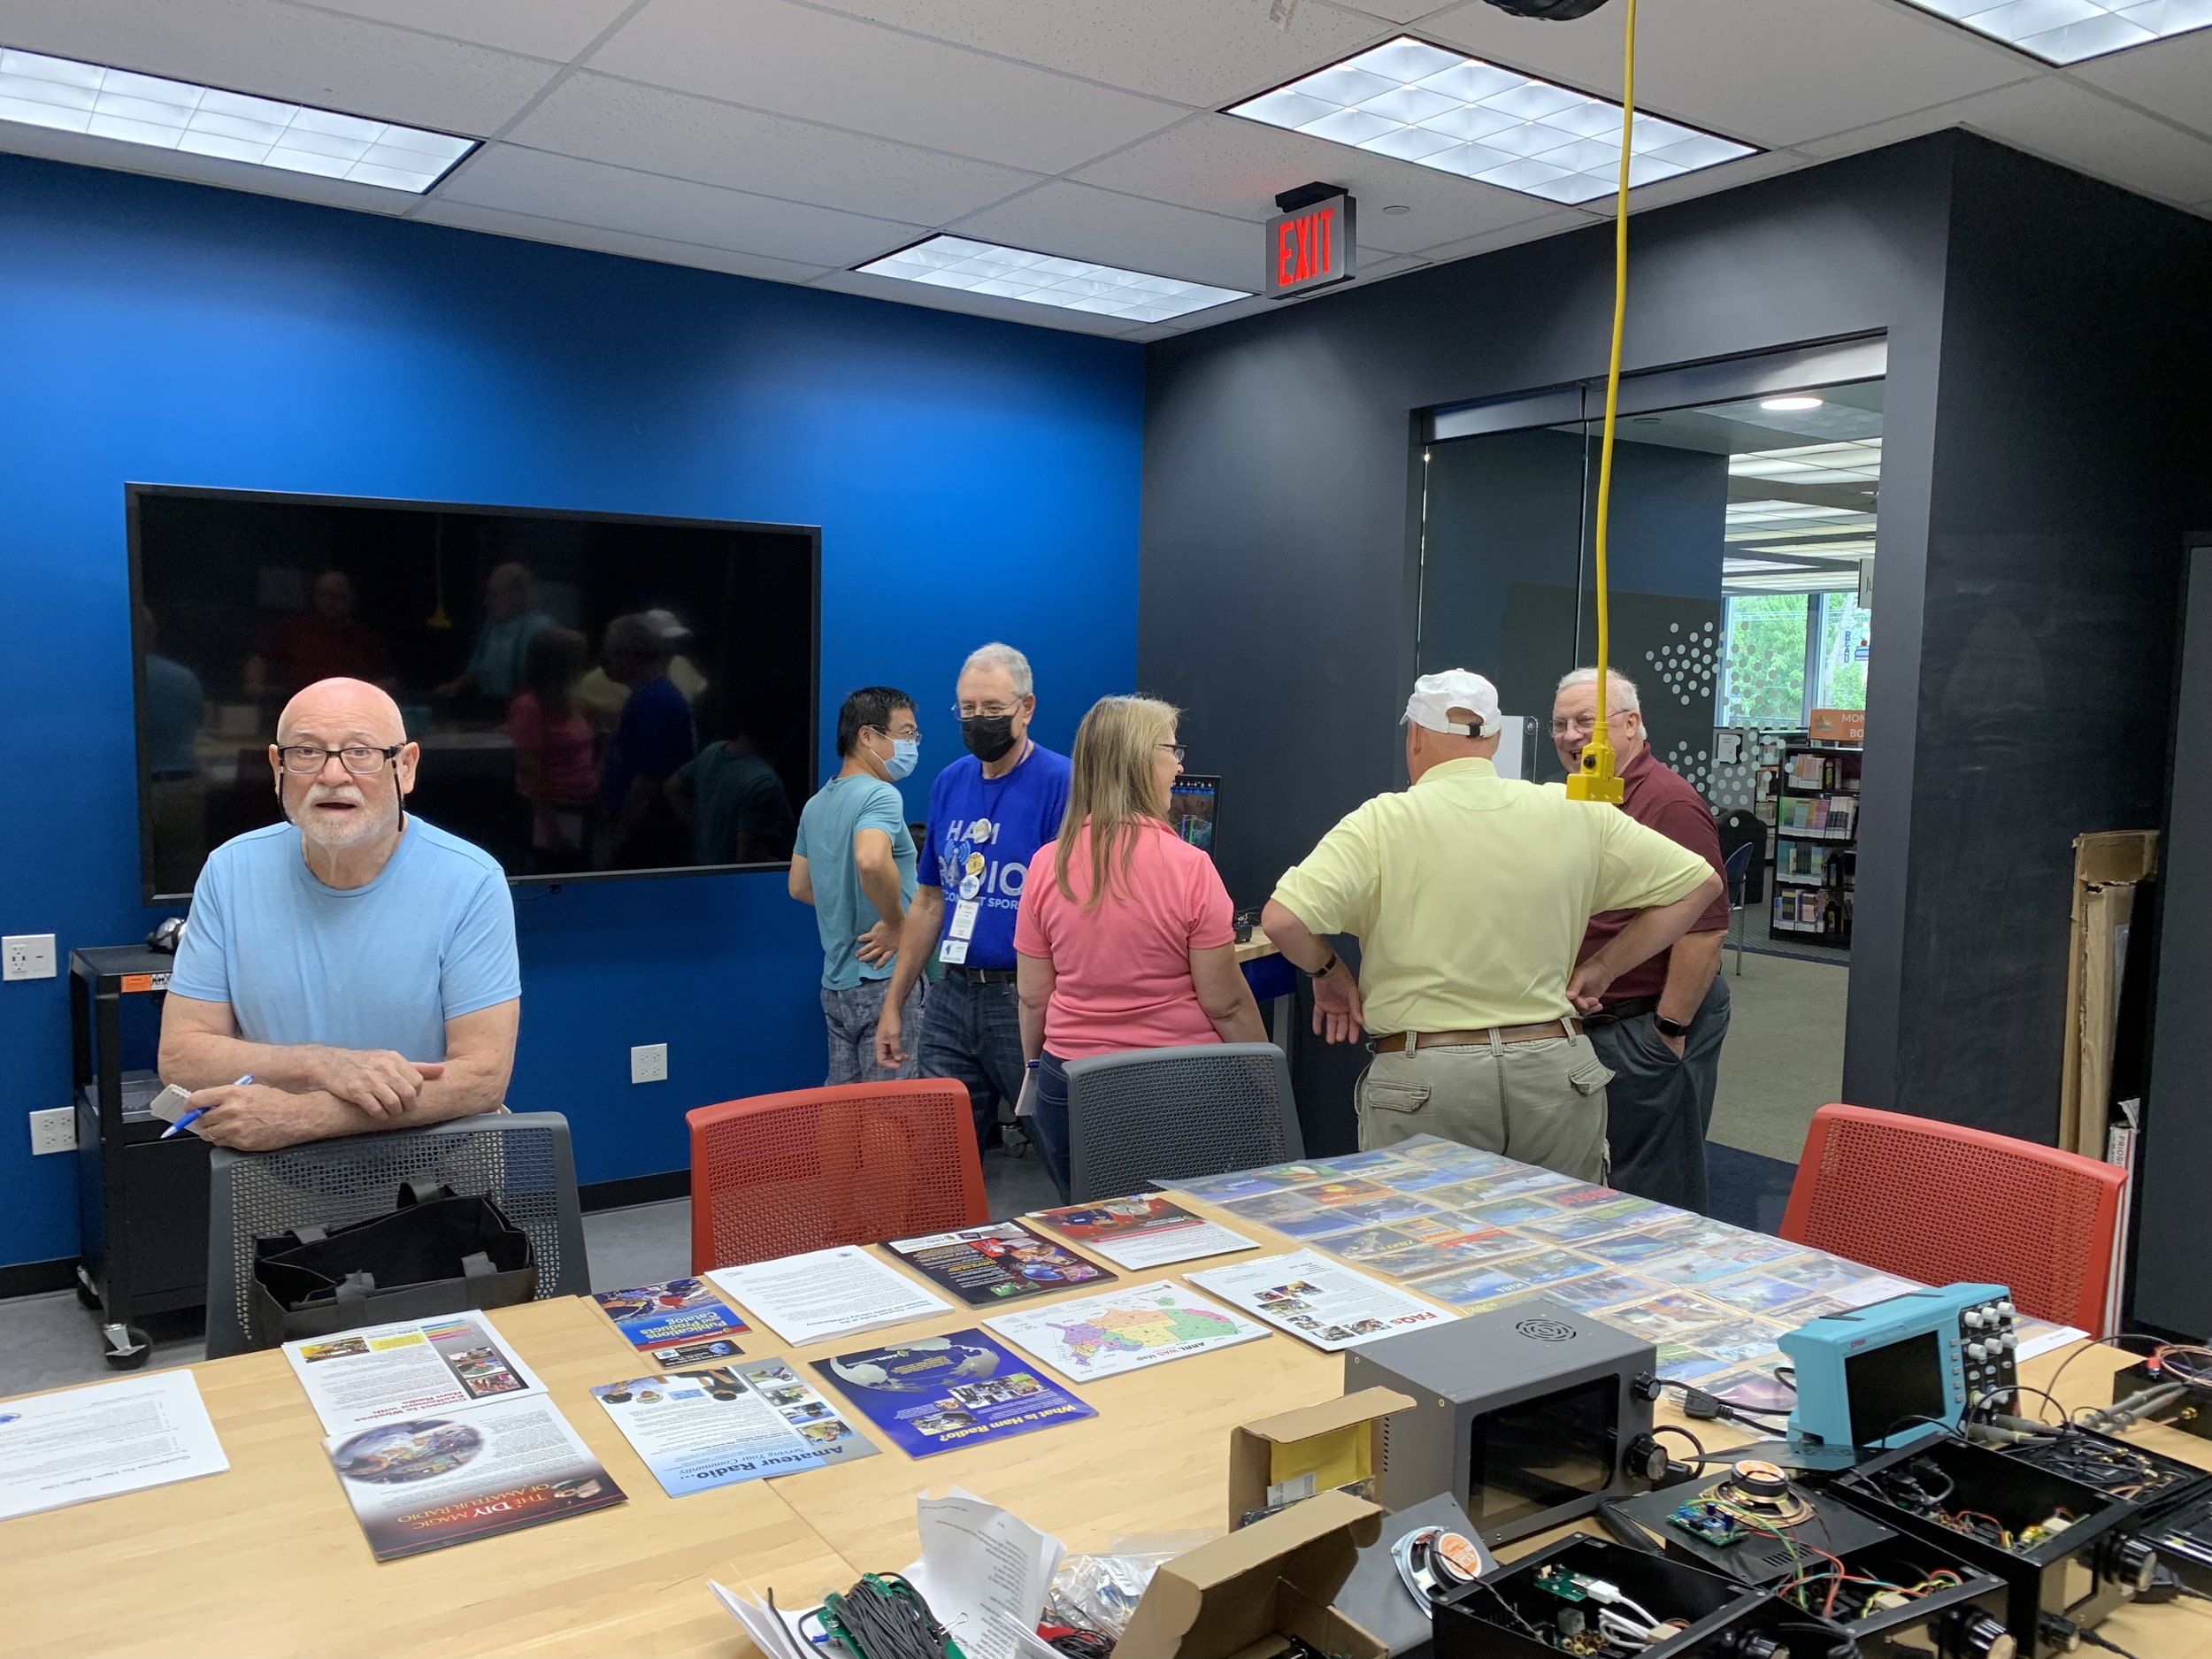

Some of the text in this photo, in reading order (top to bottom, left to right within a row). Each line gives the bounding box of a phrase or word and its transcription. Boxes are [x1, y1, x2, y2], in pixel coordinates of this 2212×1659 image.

[1278, 207, 1334, 288] EXIT
[1843, 630, 1852, 664] READ
[987, 897, 1019, 910] SPOR
[665, 1311, 718, 1325] Catalog
[1389, 1311, 1439, 1325] FAQs
[639, 1319, 702, 1335] Products
[645, 1320, 728, 1339] Publications
[1179, 1341, 1205, 1352] ARRL
[878, 1351, 898, 1361] ARRL
[1136, 1353, 1157, 1362] Map
[401, 1390, 463, 1405] Ham Radio
[401, 1394, 465, 1409] Excitement
[421, 1397, 467, 1409] Connect
[354, 1409, 404, 1422] Wireless
[1037, 1404, 1077, 1416] What
[989, 1417, 1024, 1429] Ham
[939, 1425, 990, 1442] Radio?
[679, 1447, 805, 1476] Serving Your Community
[680, 1445, 843, 1479] Amateur Radio...
[62, 1477, 92, 1486] Radio
[397, 1483, 550, 1524] OF AMATEUR RADIO
[411, 1493, 548, 1530] THE DIY MAGIC
